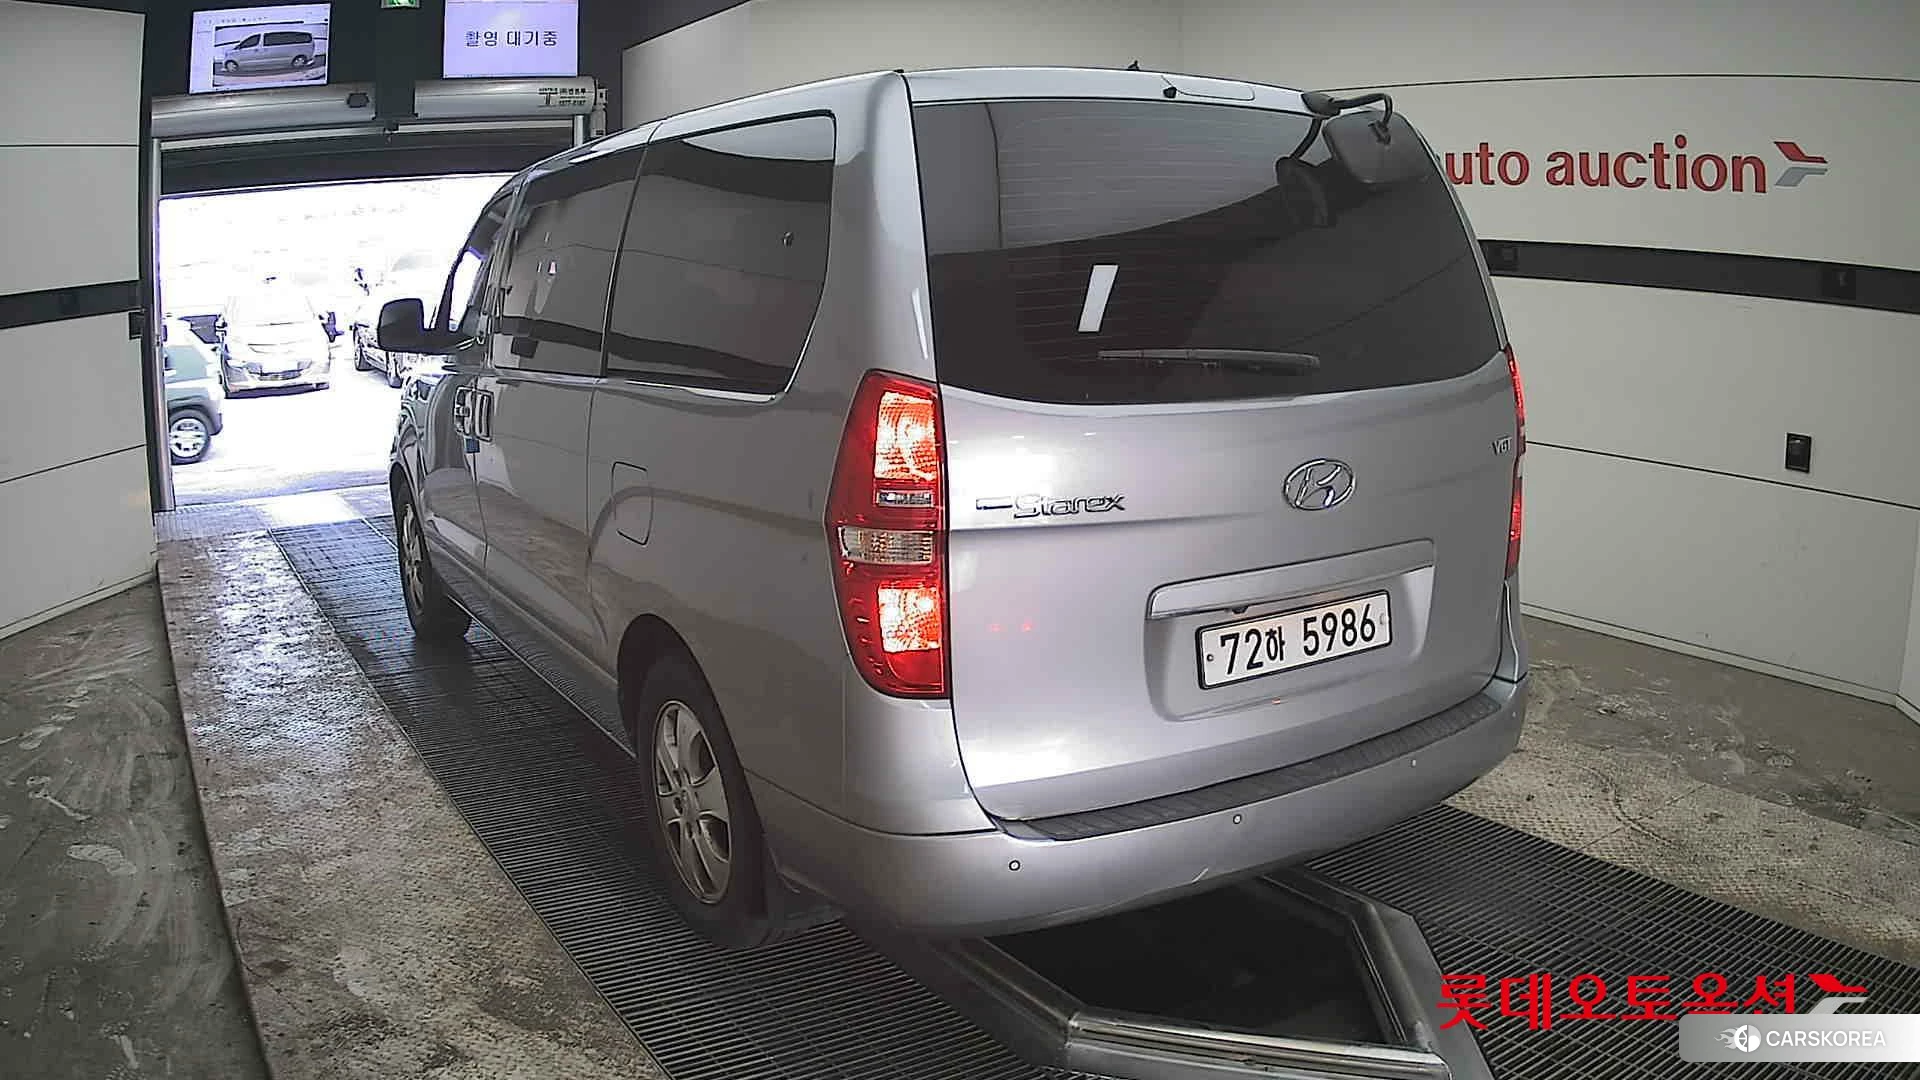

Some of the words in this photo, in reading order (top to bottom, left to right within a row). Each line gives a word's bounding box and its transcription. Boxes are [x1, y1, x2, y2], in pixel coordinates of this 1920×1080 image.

[506, 30, 557, 47] 대기중
[1437, 141, 1530, 187] uto
[1545, 134, 1767, 194] auction
[1013, 493, 1126, 519] Starex
[1219, 625, 1286, 675] 72하
[1302, 603, 1377, 657] 5986
